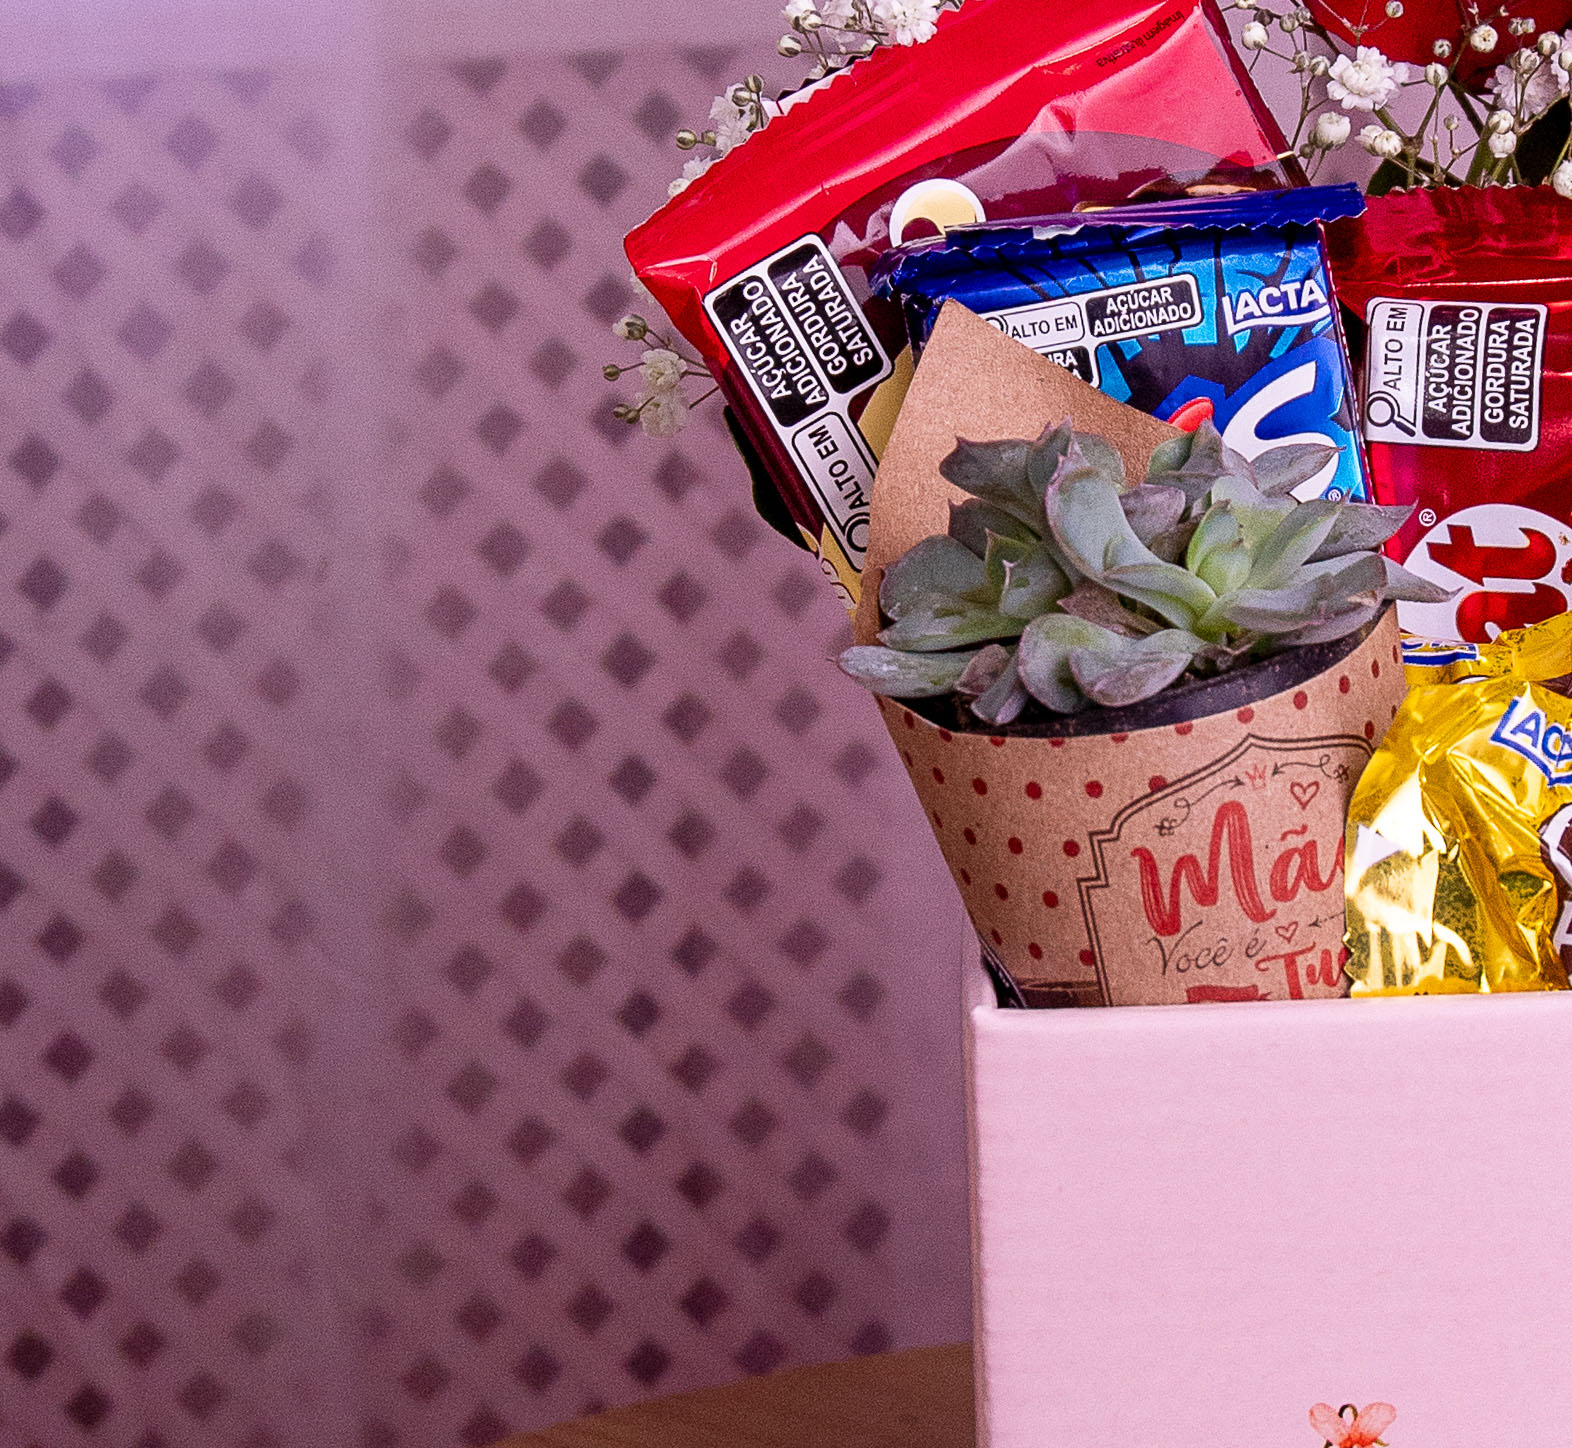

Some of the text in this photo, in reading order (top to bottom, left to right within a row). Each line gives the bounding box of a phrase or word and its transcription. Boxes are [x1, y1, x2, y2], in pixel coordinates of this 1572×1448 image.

[742, 280, 827, 405] ADICIONADO
[781, 271, 848, 376] GORDURA
[802, 254, 873, 366] SATURADA
[1011, 314, 1078, 340] ALTO EM
[1093, 302, 1192, 337] ADICIONADO
[1106, 286, 1173, 316] AÇÚCAR
[1222, 280, 1331, 335] LACTA
[730, 312, 792, 400] AÇÚCAR
[1383, 307, 1408, 392] ALTO EM
[1425, 325, 1453, 413] AÇÚCAR
[1451, 308, 1480, 436] ADICIONADO
[1484, 320, 1510, 424] GORDURA
[1509, 318, 1536, 429] SATURADA
[808, 425, 870, 510] ALTO EM
[1131, 800, 1346, 937] Mã
[1146, 921, 1267, 976] Você é
